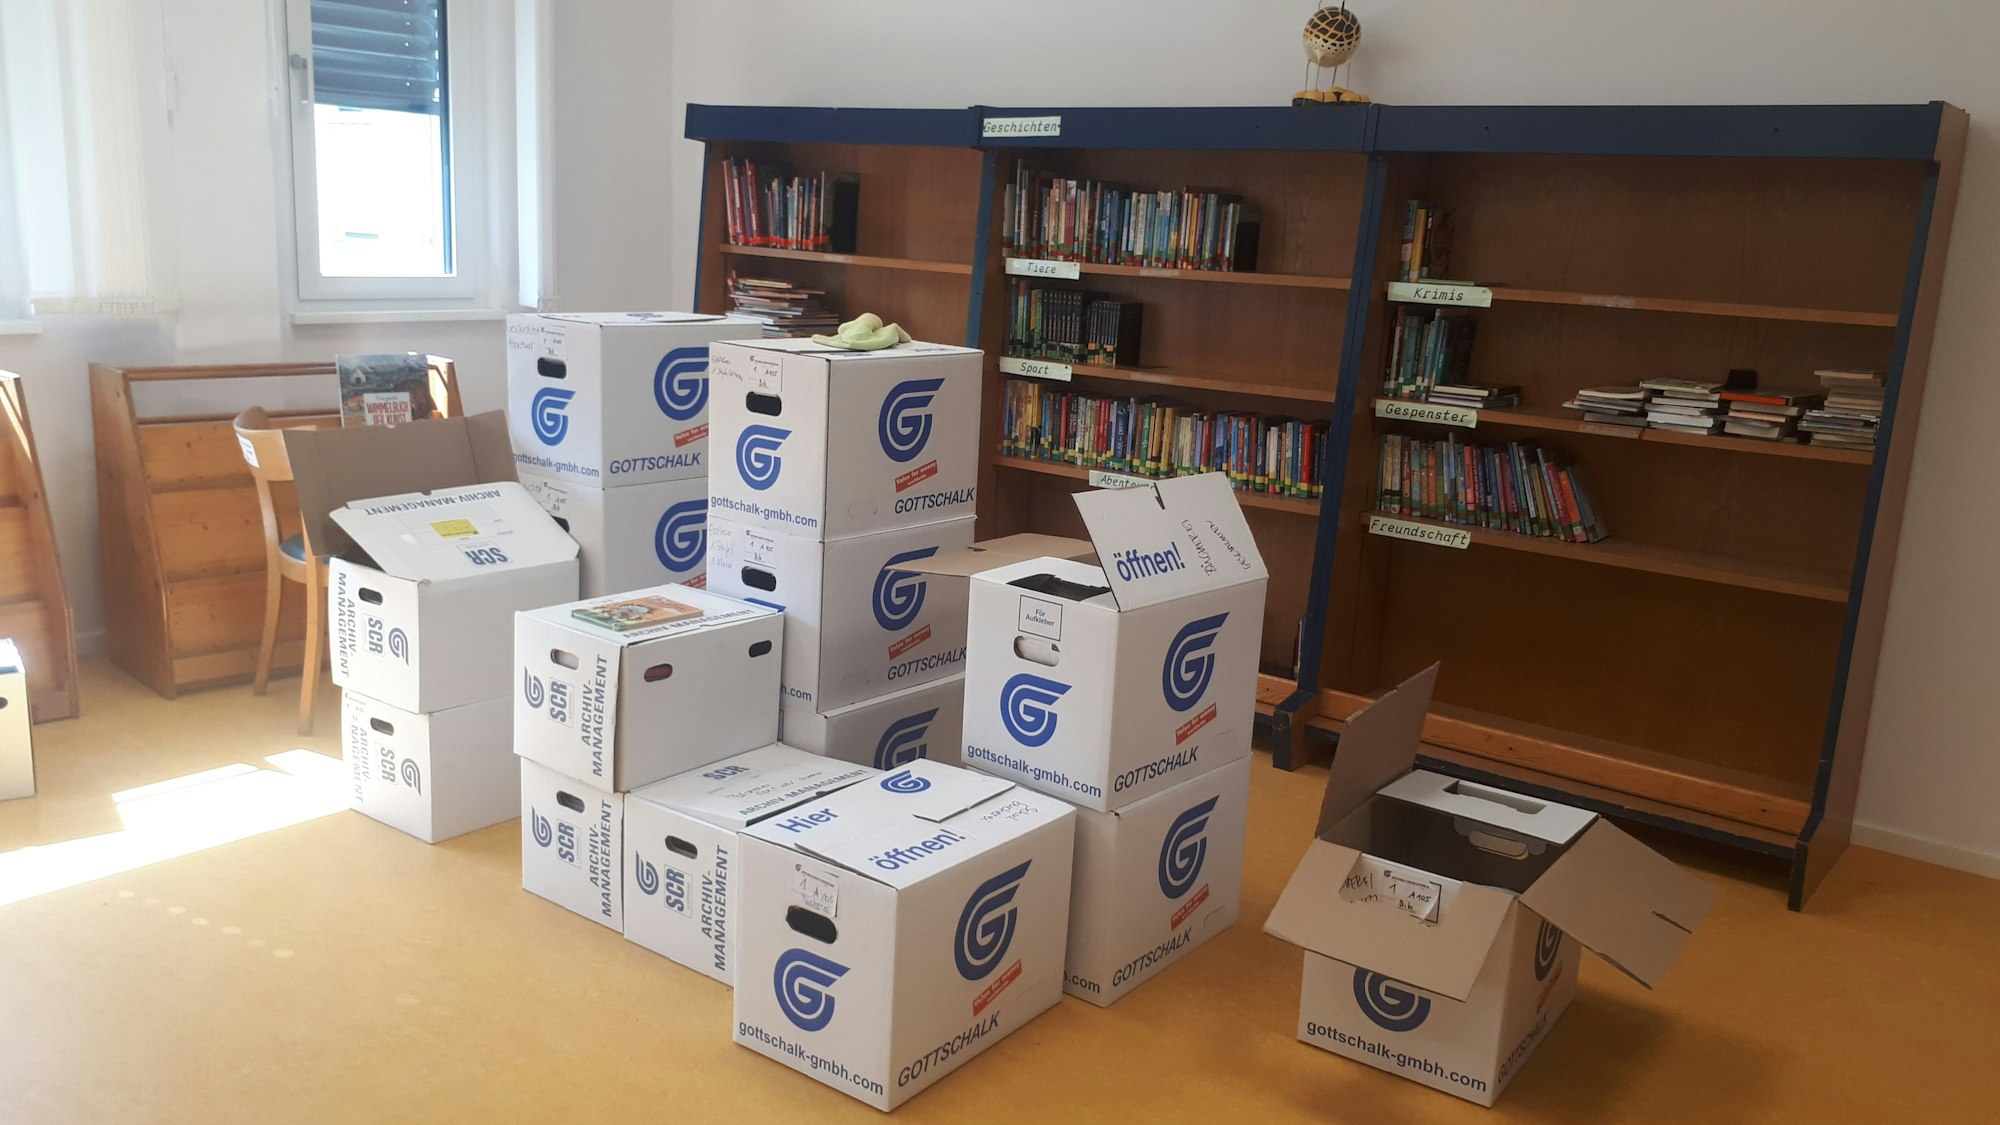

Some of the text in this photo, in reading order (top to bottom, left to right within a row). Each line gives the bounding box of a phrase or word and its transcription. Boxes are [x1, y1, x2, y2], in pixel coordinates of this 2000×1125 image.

[983, 121, 1057, 133] Geschichten
[1027, 262, 1057, 275] Tiere
[1413, 287, 1464, 302] Krimis
[1020, 362, 1050, 375] Sport
[1384, 403, 1468, 424] Gespenster
[512, 453, 600, 477] gottschalk-gmbh.com
[609, 452, 702, 474] GOTTSCHALK
[366, 489, 501, 517] ARCHIV-MANAGEMENT
[710, 495, 818, 529] gottschalk-gmbh.com
[894, 487, 975, 514] GOTTSCHALK
[1370, 519, 1469, 545] Freundschaft
[465, 547, 509, 566] SCR
[1113, 541, 1186, 582] öffnen!
[337, 572, 349, 678] MANAGEMENT
[348, 598, 356, 657] ARCHIV-
[622, 609, 756, 638] ARCHIV-MANAGEMENT
[1025, 613, 1056, 627] Aufkleber
[1035, 608, 1046, 618] Für
[367, 617, 384, 654] SCR
[887, 646, 967, 681] GOTTSCHALK
[549, 680, 568, 723] SCR
[580, 679, 593, 747] ARCHIV-
[592, 654, 608, 777] MANAGEMENT
[360, 727, 370, 782] ARCHIV-
[380, 746, 396, 783] SCR
[703, 765, 750, 780] SCR
[967, 744, 1102, 799] gottschalk-gmbh.com
[1114, 746, 1199, 792] GOTTSCHALK
[738, 769, 869, 816] ARCHIV-MANAGEMENT
[775, 807, 839, 833] Hier
[558, 821, 575, 863] SCR
[589, 823, 600, 887] ARCHIV-
[600, 799, 612, 918] MANAGEMENT
[868, 828, 967, 870] öffnen!
[666, 868, 685, 913] SCR
[701, 870, 714, 939] ARCHIV-
[714, 844, 729, 972] MANAGEMENT
[1389, 883, 1397, 893] 1
[1112, 927, 1192, 987] GOTTSCHALK
[738, 1020, 884, 1096] gottschalk-gmbh.com
[898, 1009, 1001, 1088] GOTTSCHALK
[1306, 1021, 1488, 1093] gottschalk-gmbh.com
[1497, 1009, 1549, 1083] GOTTSCHALK
